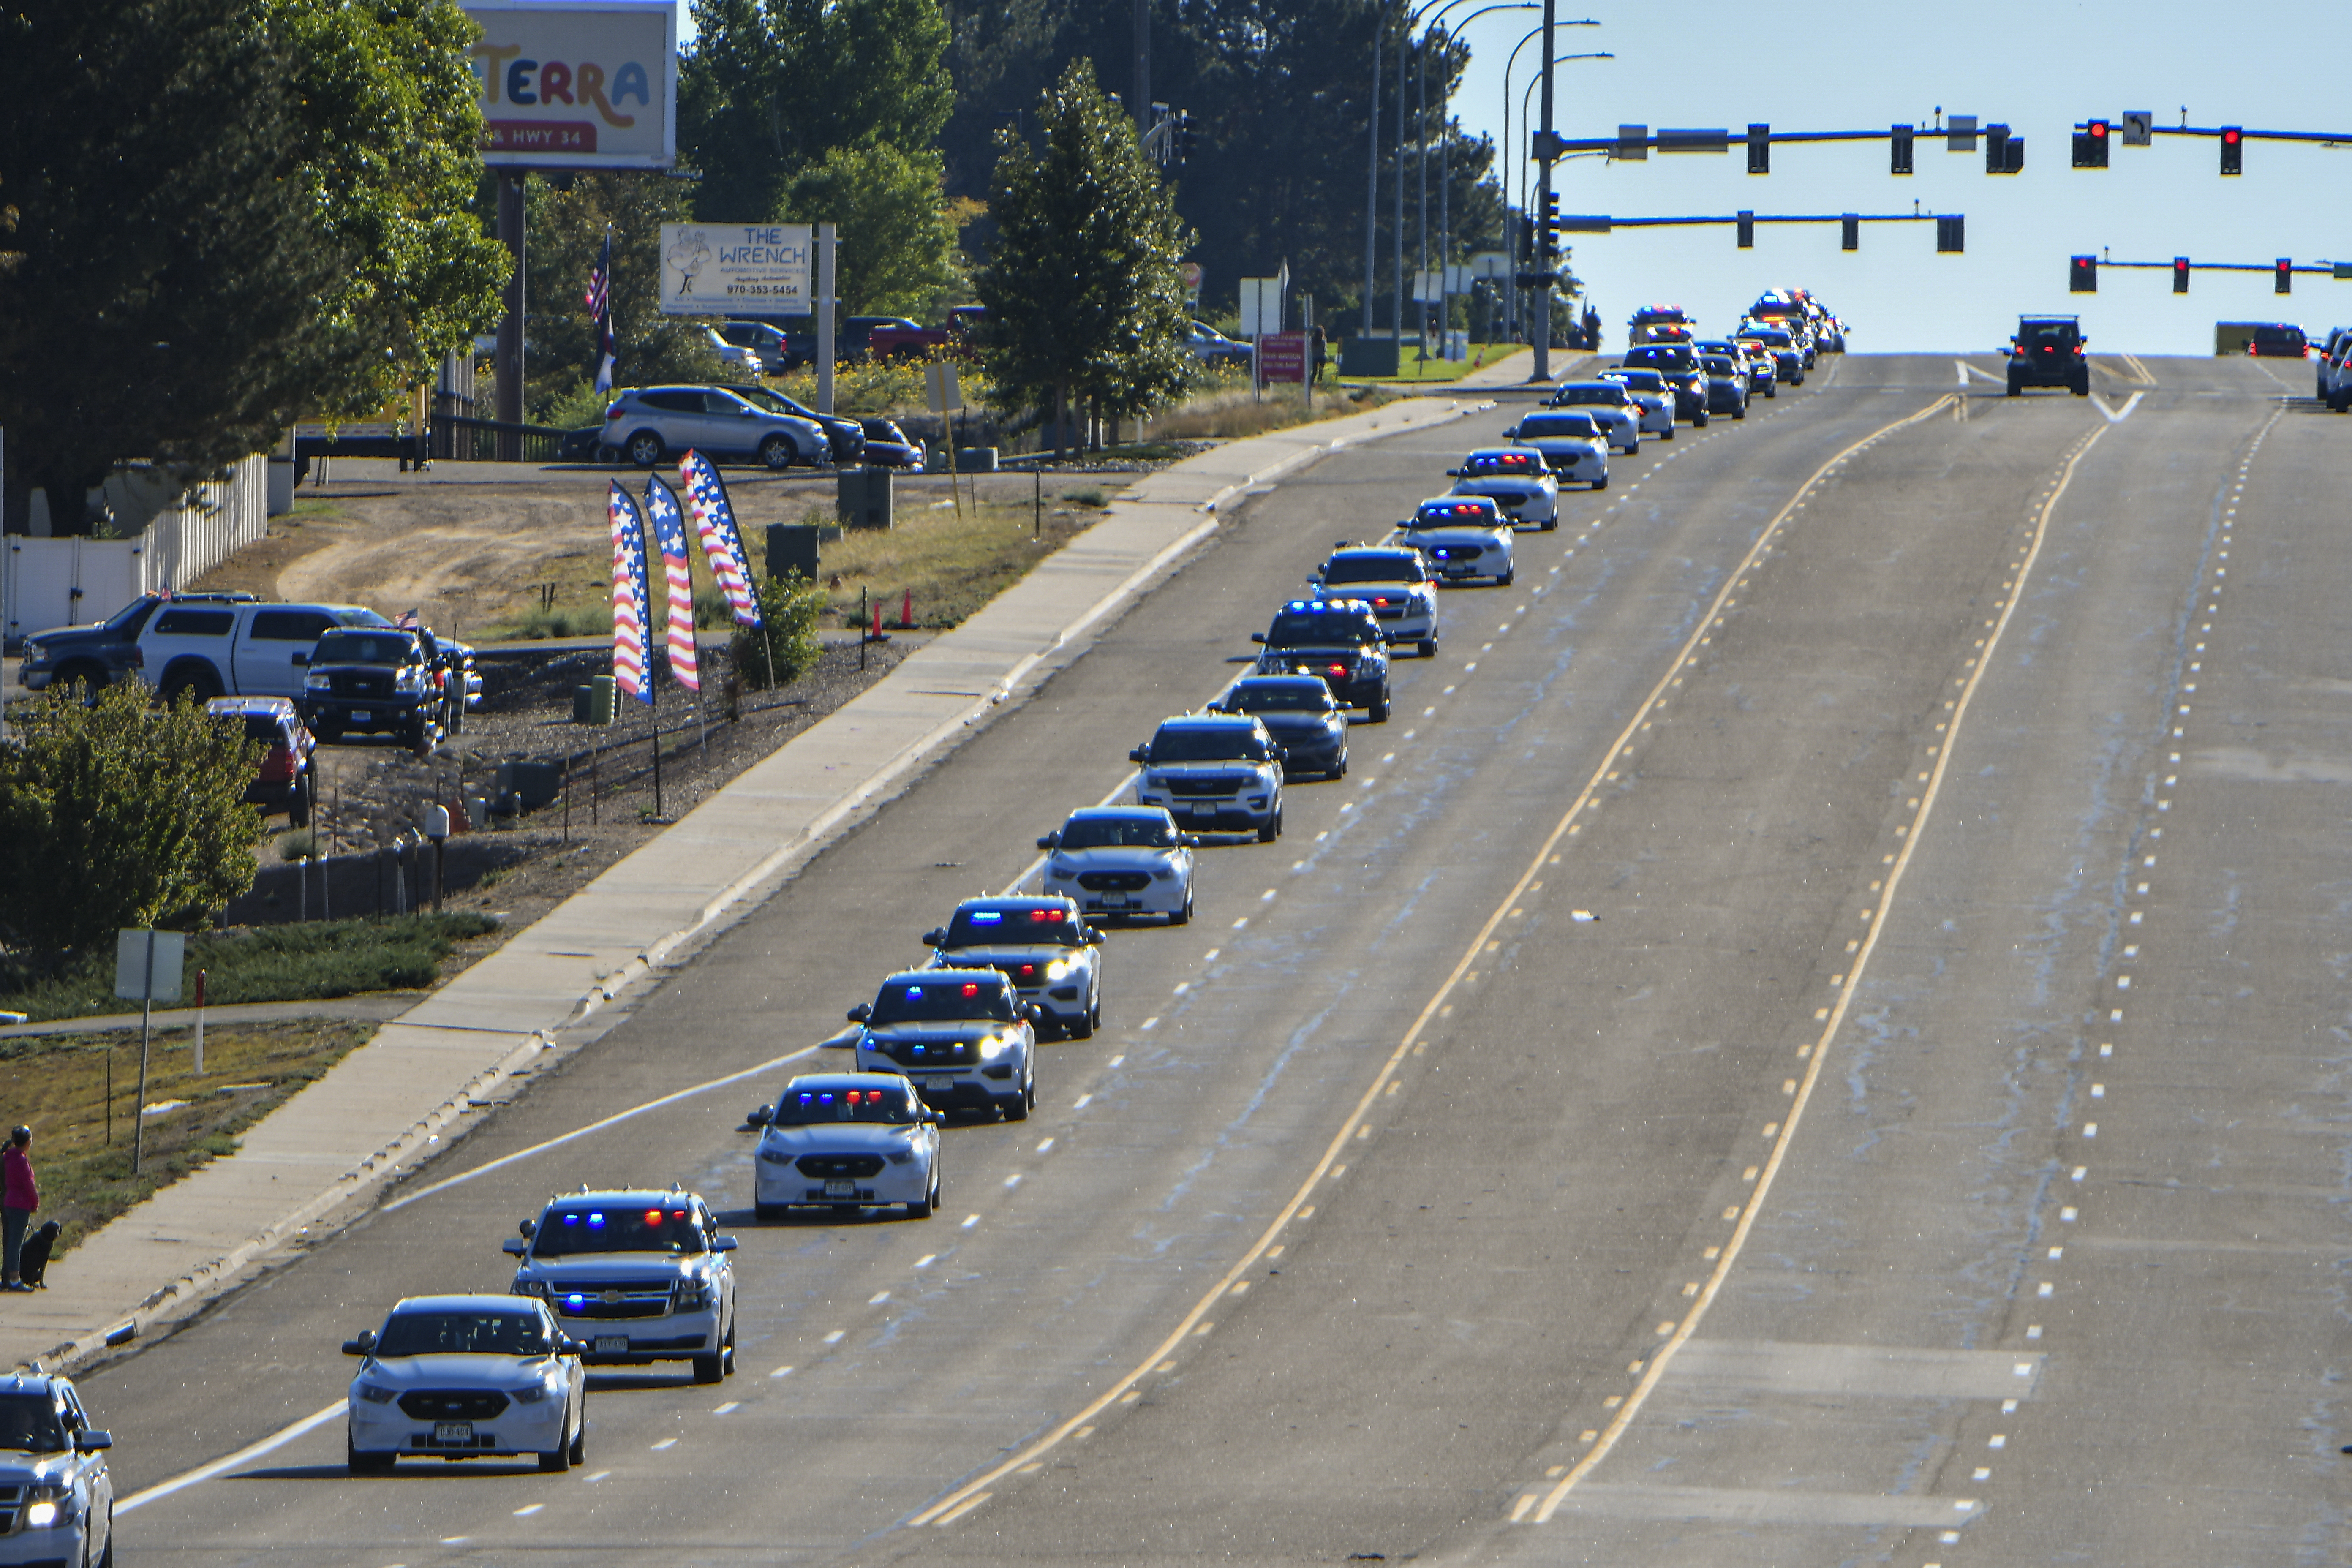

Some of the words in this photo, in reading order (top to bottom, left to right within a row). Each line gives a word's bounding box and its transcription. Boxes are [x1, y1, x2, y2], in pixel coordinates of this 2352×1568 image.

[471, 44, 649, 128] TERRA
[512, 129, 553, 143] HWY
[561, 131, 580, 144] 34
[745, 228, 781, 244] THE
[720, 246, 805, 263] WRENCH
[727, 284, 798, 294] 970-353-5454
